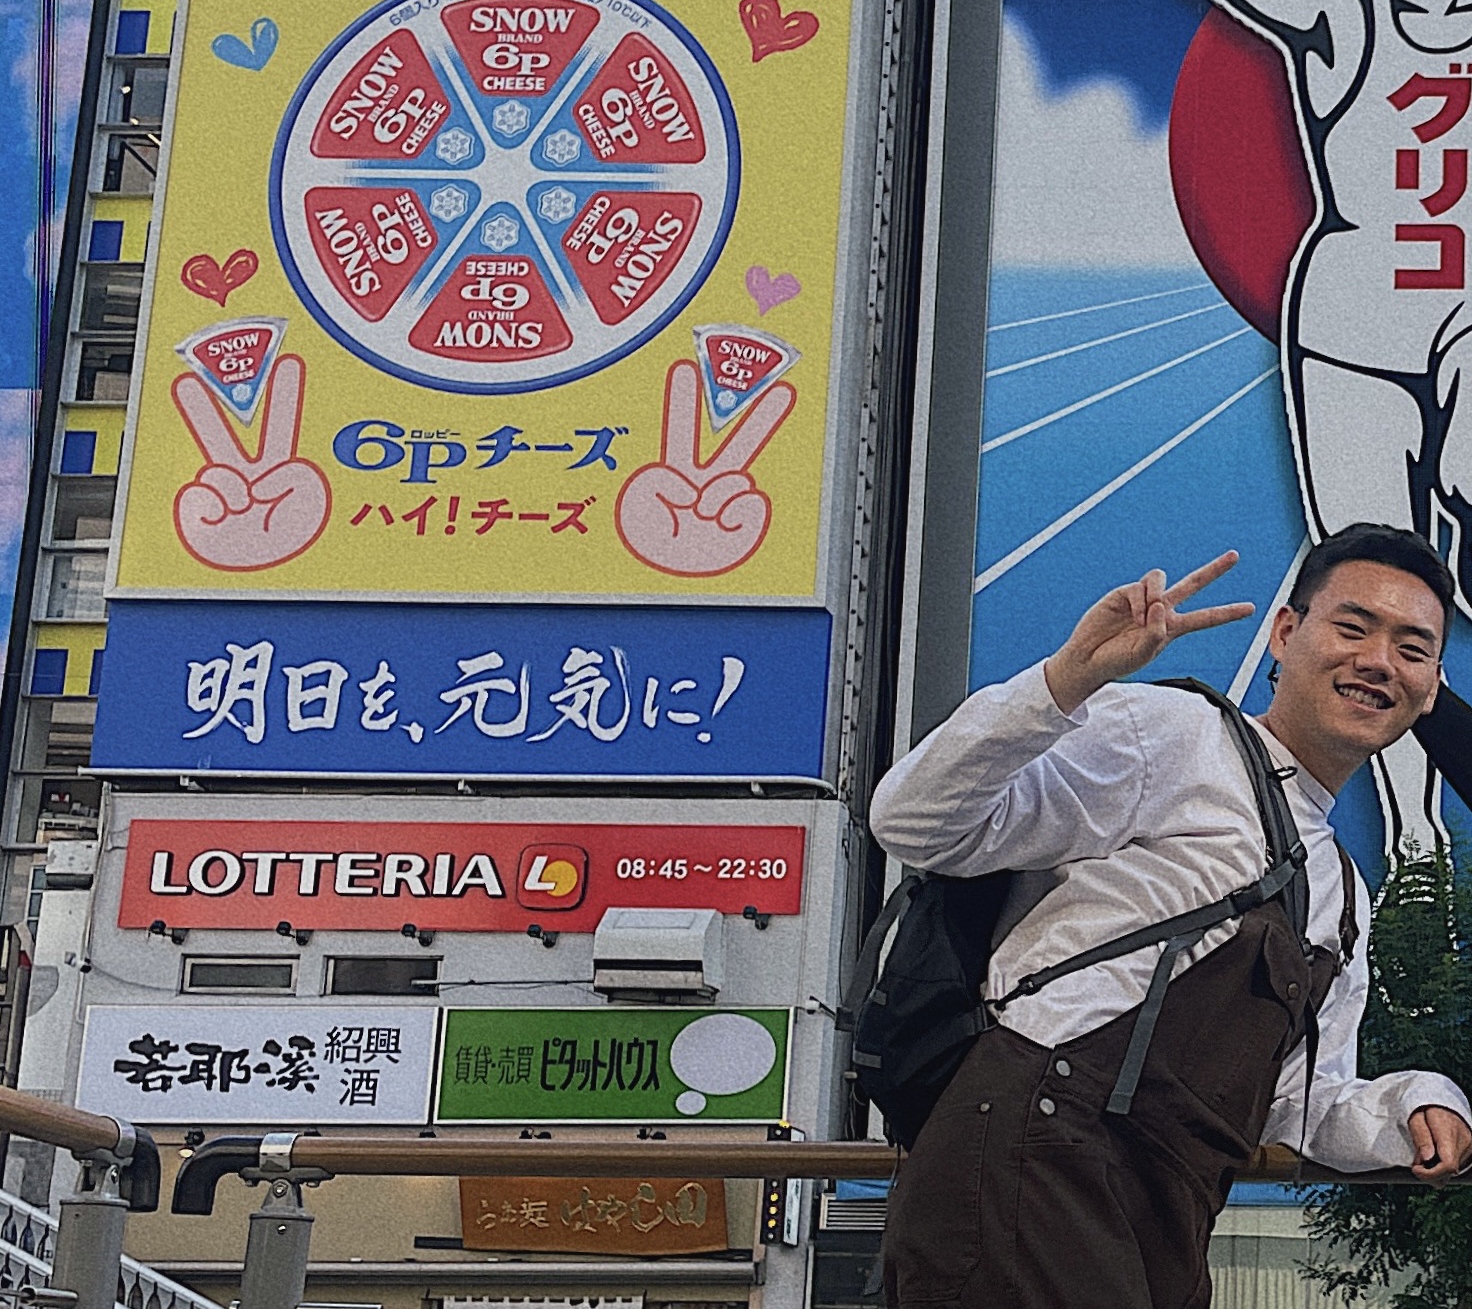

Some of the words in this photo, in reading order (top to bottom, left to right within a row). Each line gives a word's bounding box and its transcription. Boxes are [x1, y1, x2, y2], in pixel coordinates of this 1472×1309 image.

[470, 7, 576, 33] SNOW
[497, 33, 543, 44] BRAND
[329, 47, 405, 140] SNOW
[366, 83, 400, 123] BRAND
[483, 76, 546, 92] CHEESE
[627, 56, 695, 146] SNOW
[402, 101, 447, 155] CHEESE
[578, 103, 616, 159] CHEESE
[628, 90, 656, 131] BRAND
[394, 193, 432, 249] CHEESE
[566, 197, 611, 251] CHEESE
[315, 208, 382, 298] SNOW
[353, 222, 379, 263] BRAND
[610, 211, 684, 308] SNOW
[614, 227, 646, 269] BRAND
[465, 261, 529, 276] CHEESE
[434, 321, 544, 348] SNOW
[467, 309, 515, 321] BRAND
[207, 332, 259, 356] SNOW
[718, 340, 771, 363] SNOW
[149, 849, 505, 900] LOTTERIA
[323, 1025, 402, 1065] 紹興
[540, 1037, 660, 1091] ピタットハウス
[339, 1068, 379, 1106] 酒
